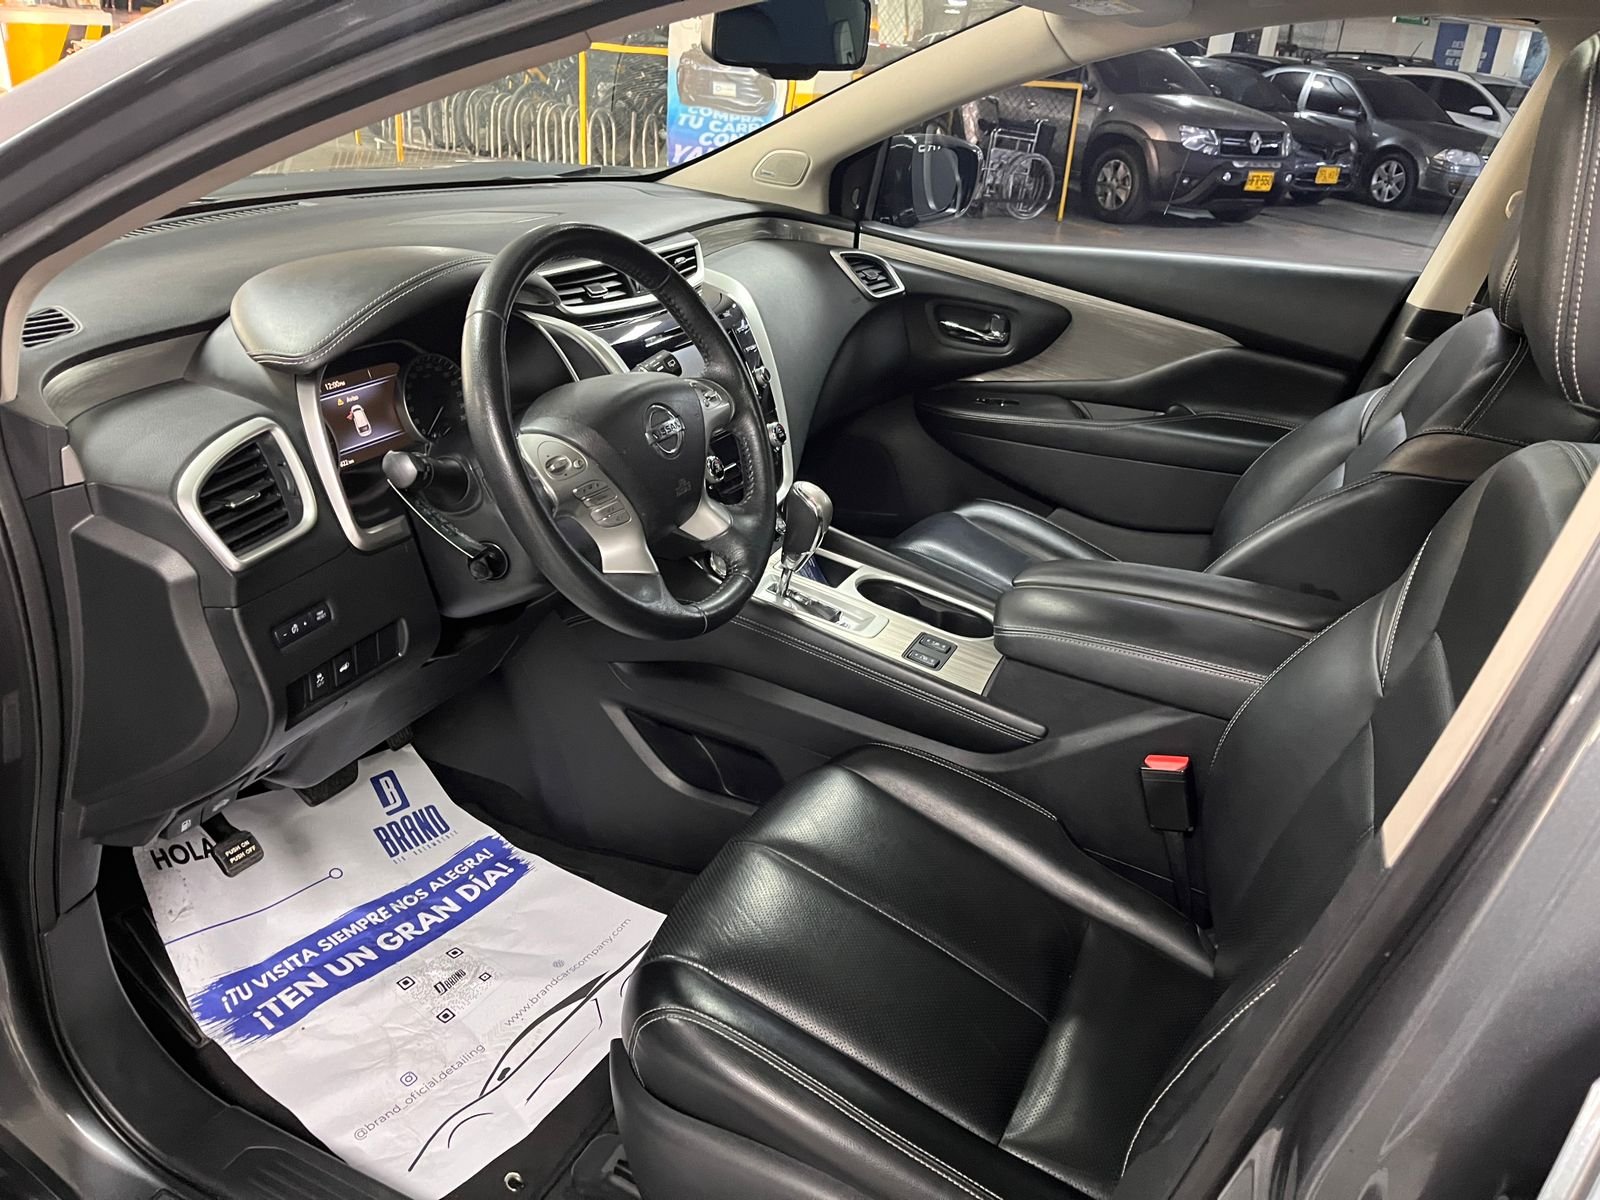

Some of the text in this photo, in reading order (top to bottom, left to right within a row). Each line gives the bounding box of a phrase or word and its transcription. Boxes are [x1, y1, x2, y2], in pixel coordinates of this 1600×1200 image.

[677, 113, 704, 129] TU
[652, 419, 682, 440] NISSAN
[225, 844, 241, 857] PUSH
[229, 844, 256, 864] PUSH OFF
[372, 804, 451, 858] BRAND
[251, 948, 320, 989] VISITA
[317, 906, 393, 952] SIEMPRE
[389, 888, 429, 914] NOS
[428, 847, 495, 893] ALEGRA!
[252, 861, 515, 1031] ¡TEN UN GRAN DÍA!
[504, 917, 632, 1027] www.brandcarscompany.com
[353, 1043, 486, 1141] @brand_oficial.detailing
